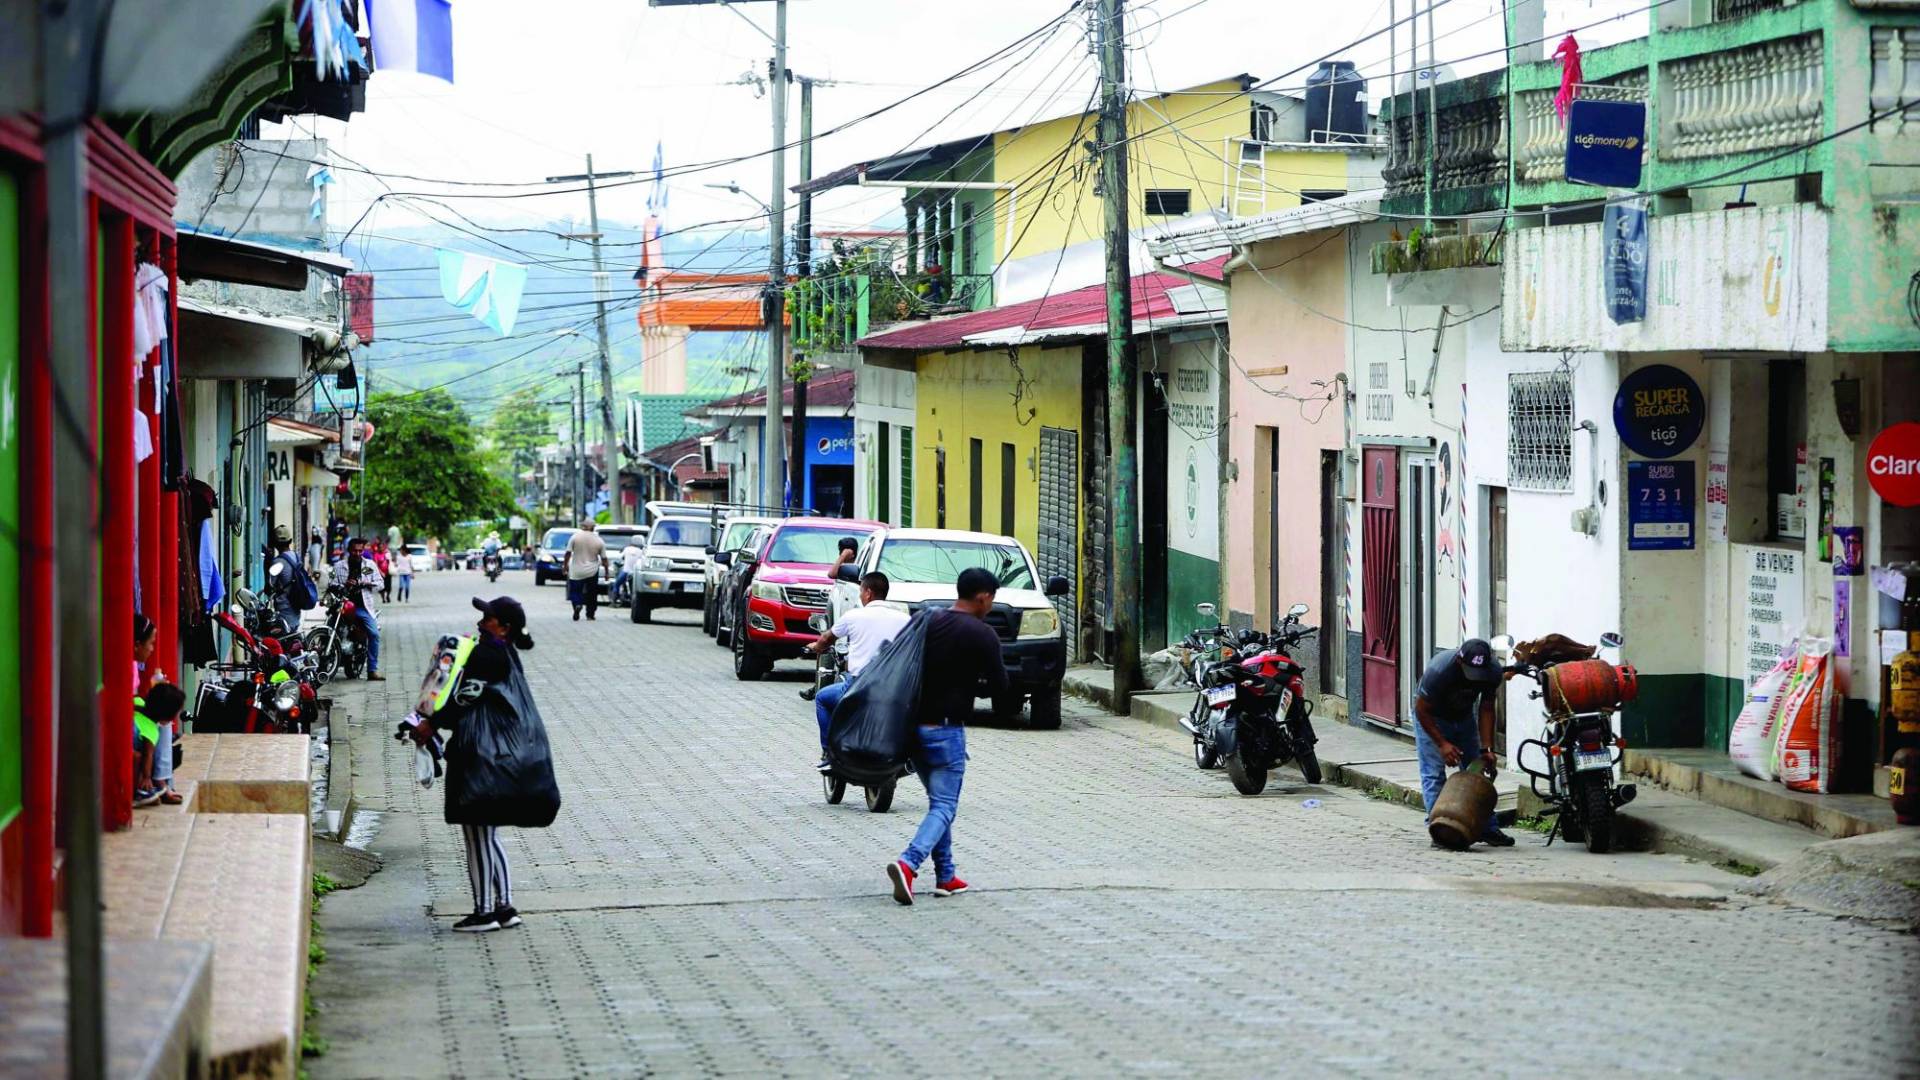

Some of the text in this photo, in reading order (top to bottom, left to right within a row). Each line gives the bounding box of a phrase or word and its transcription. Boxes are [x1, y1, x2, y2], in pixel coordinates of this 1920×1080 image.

[1634, 387, 1689, 406] SUPER
[1196, 405, 1214, 429] BAJOS
[1636, 404, 1691, 417] RECARGA
[832, 438, 855, 452] peps
[1651, 426, 1677, 446] tigo
[1648, 465, 1675, 474] SUPER
[1870, 455, 1920, 475] Clar
[1641, 488, 1681, 501] 7 3 1
[1756, 552, 1794, 573] SE VENDE
[1472, 655, 1484, 665] 45
[1761, 695, 1782, 737] SALVADO
